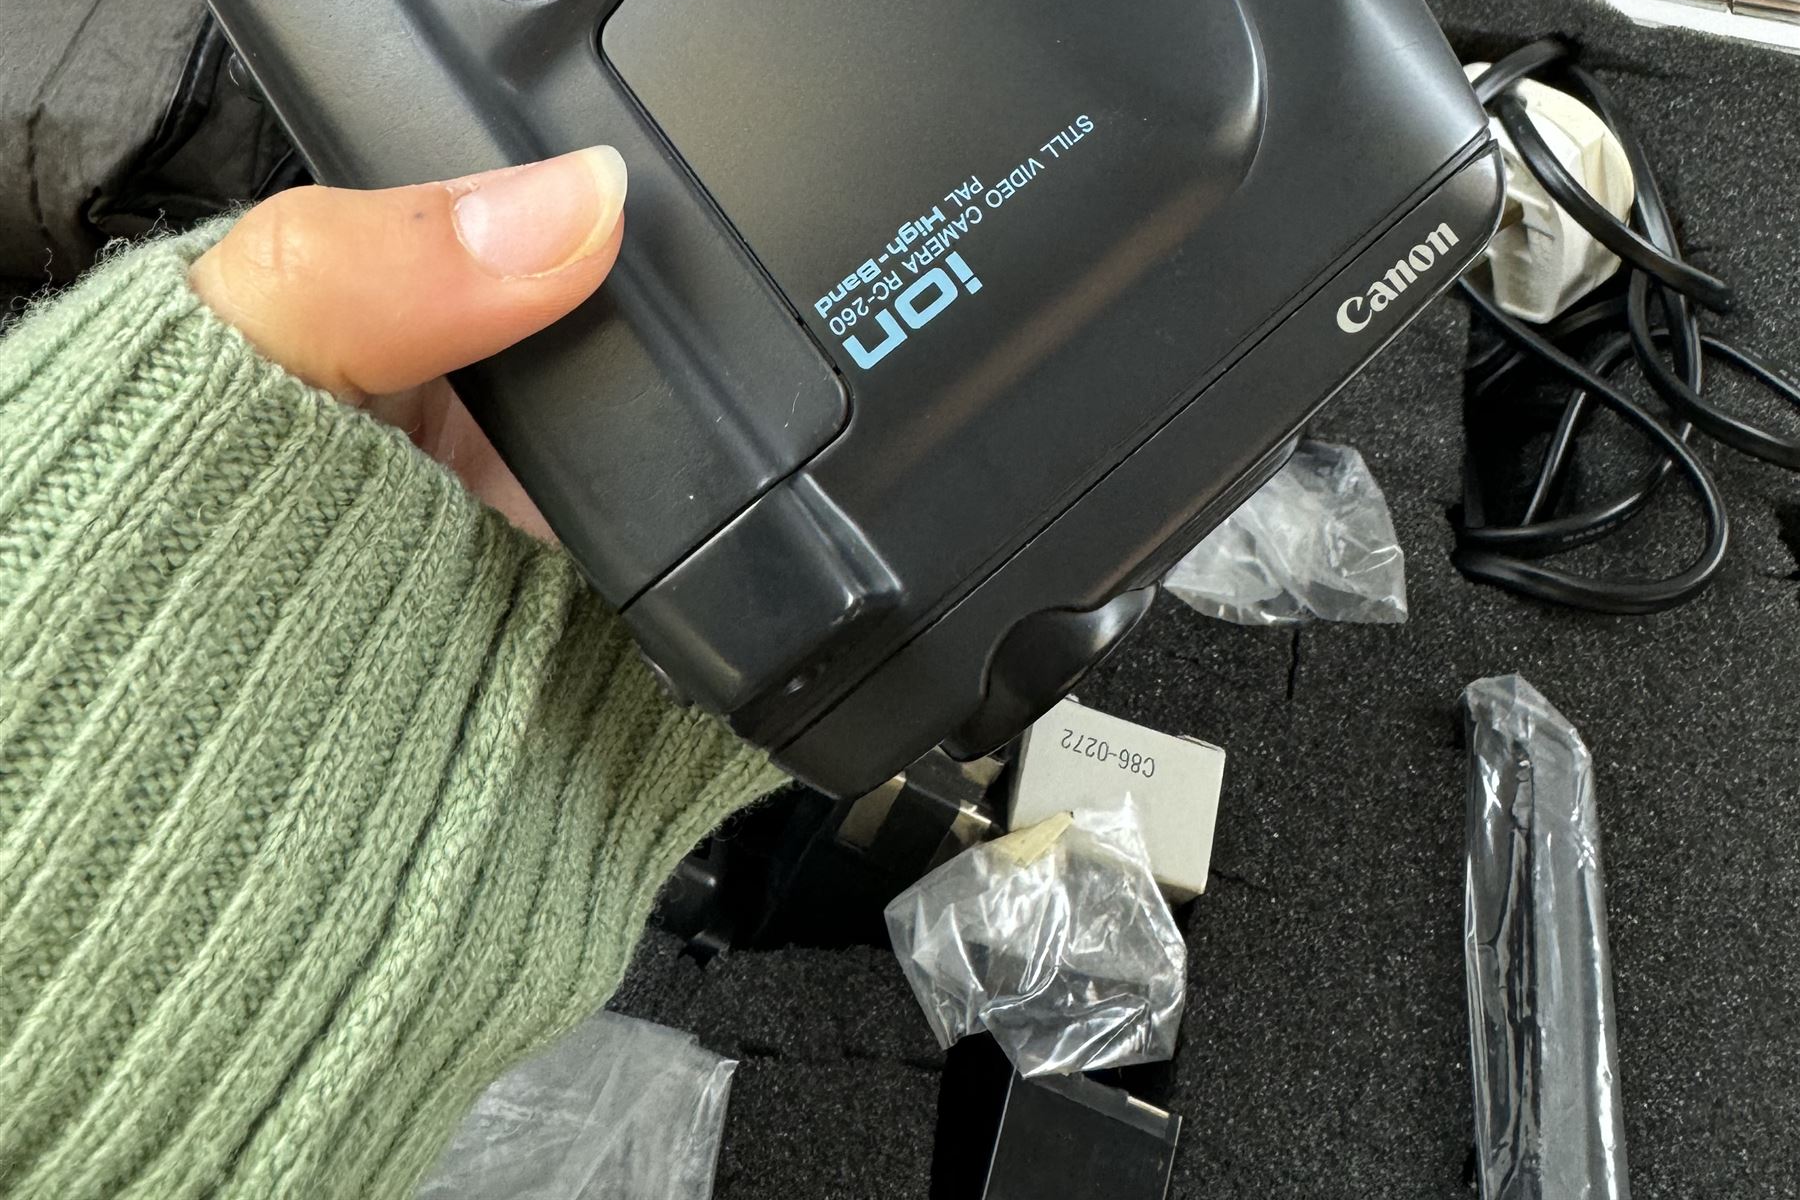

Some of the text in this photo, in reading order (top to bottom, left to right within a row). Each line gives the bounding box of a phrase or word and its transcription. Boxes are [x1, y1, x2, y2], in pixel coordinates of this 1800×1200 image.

[814, 175, 984, 319] PAL High-Band
[828, 114, 1094, 336] STILL VIDEO CAMERA RC-260
[1336, 222, 1460, 333] Canon
[842, 250, 983, 369] ion
[1061, 728, 1156, 778] C86-0272
